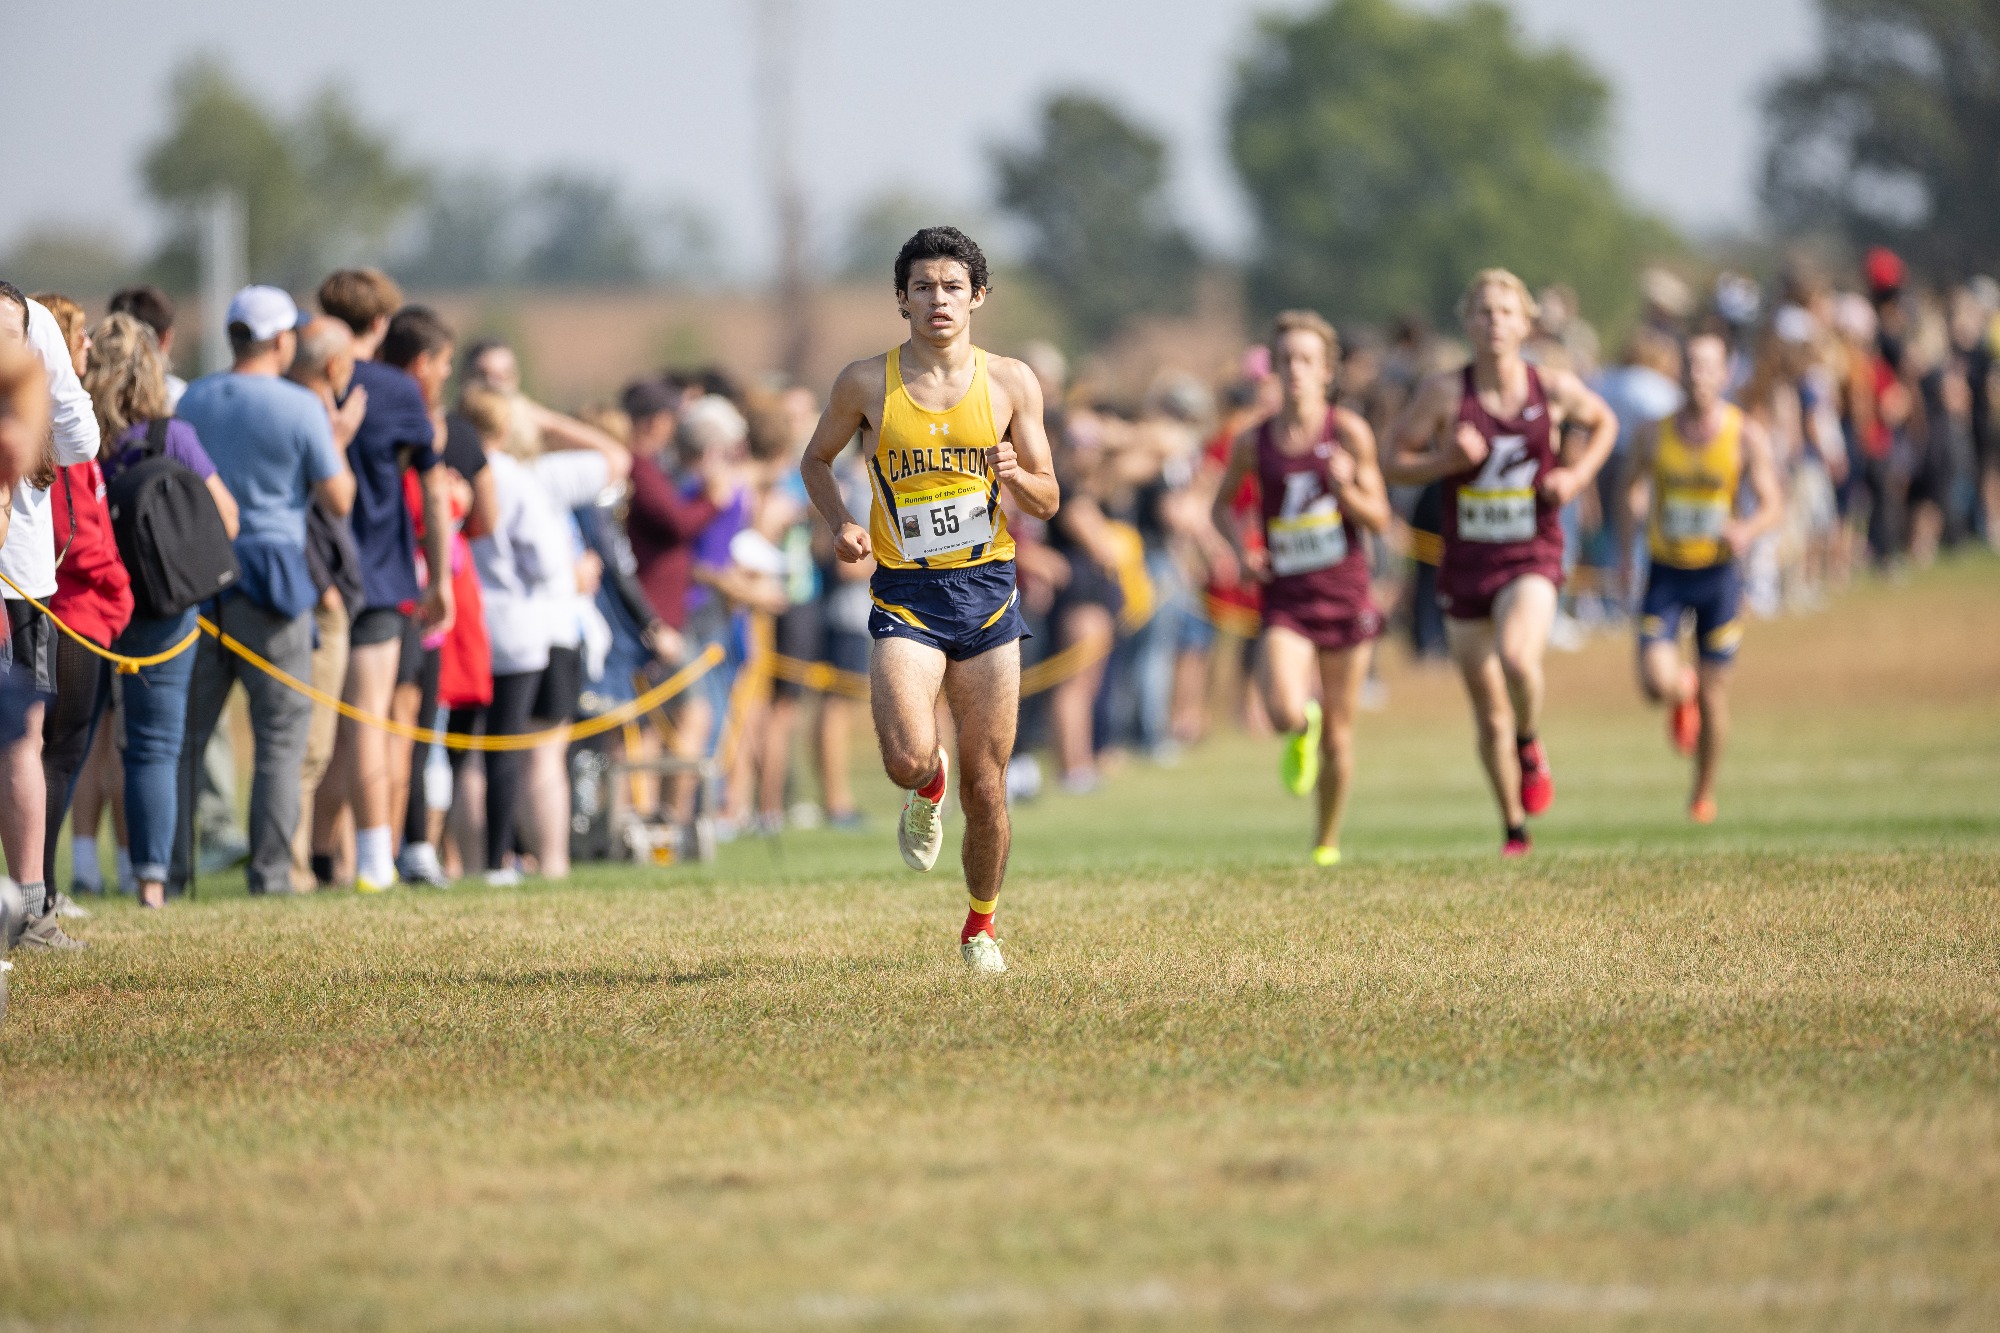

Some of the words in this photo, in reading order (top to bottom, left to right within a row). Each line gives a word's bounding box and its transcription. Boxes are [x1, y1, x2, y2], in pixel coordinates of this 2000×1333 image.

[888, 447, 990, 483] CARLETON
[904, 495, 933, 504] Running
[930, 504, 960, 537] 55
